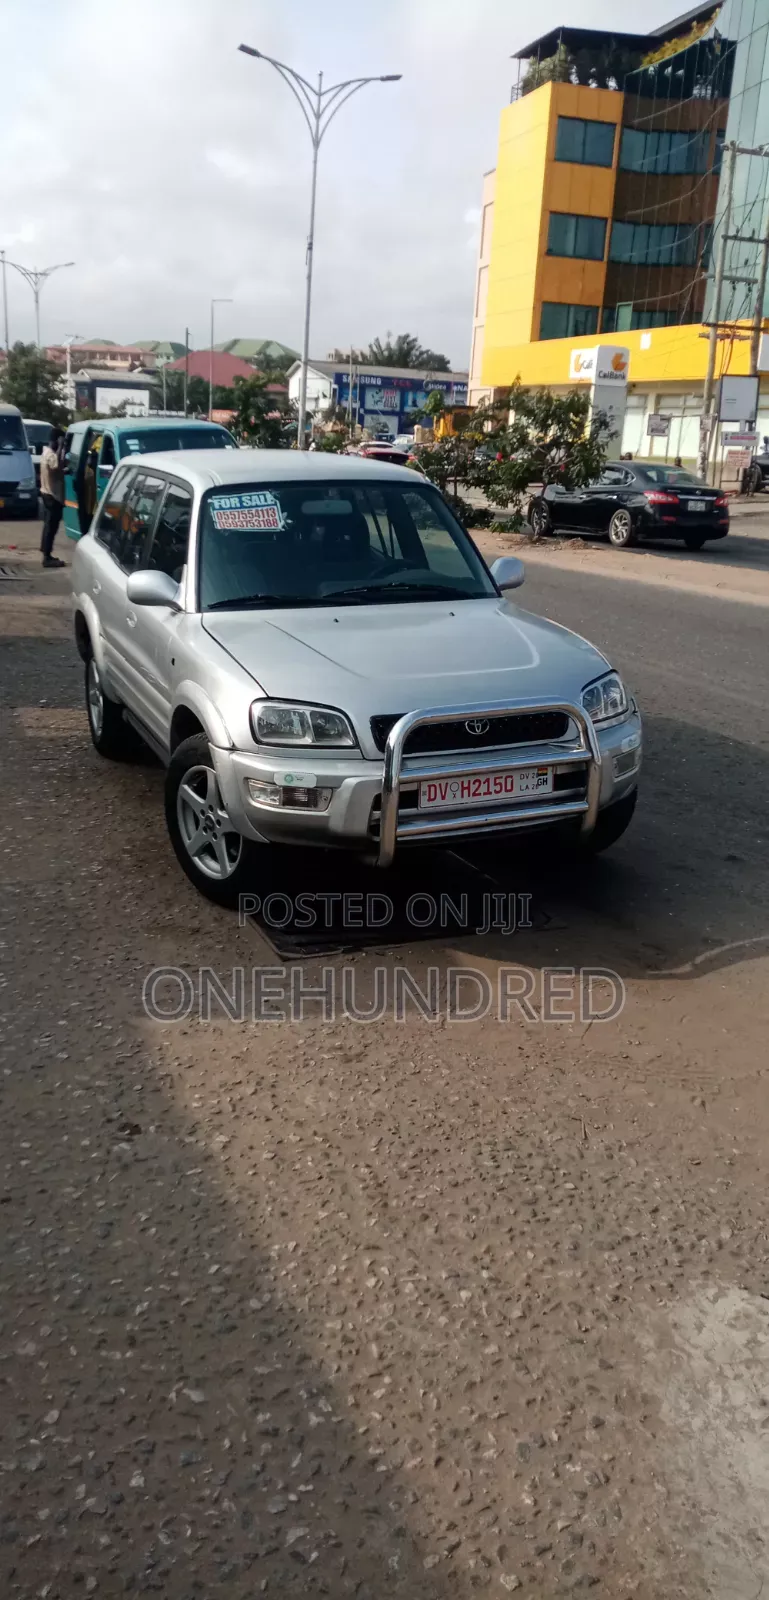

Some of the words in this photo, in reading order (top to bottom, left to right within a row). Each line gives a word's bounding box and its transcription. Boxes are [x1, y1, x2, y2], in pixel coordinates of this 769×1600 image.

[598, 370, 625, 380] CalBank
[213, 497, 241, 509] FOR
[241, 493, 275, 507] SALE
[215, 507, 277, 520] 0557554113
[519, 772, 530, 780] DV
[537, 777, 548, 786] GH
[426, 782, 449, 802] DV
[460, 775, 514, 799] H2150
